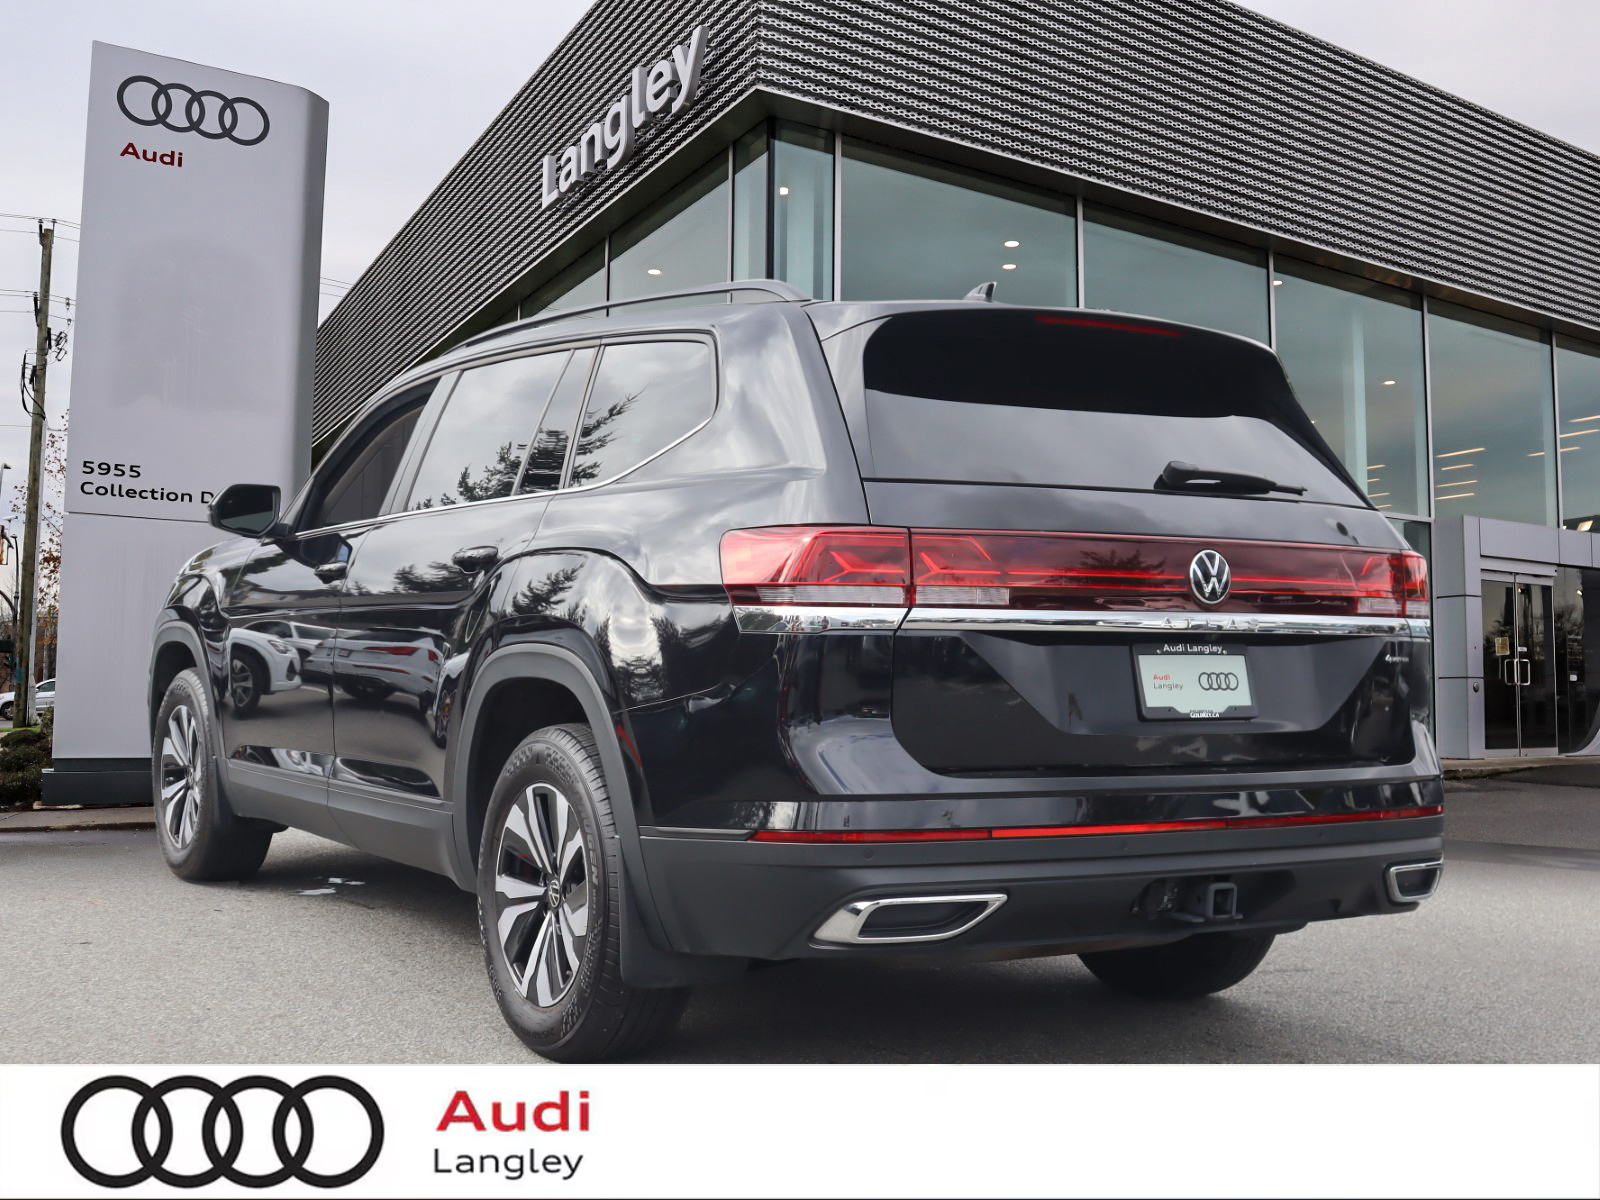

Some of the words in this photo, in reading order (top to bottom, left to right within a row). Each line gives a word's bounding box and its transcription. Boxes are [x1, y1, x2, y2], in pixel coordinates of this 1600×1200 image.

[542, 25, 709, 209] Langley
[120, 142, 183, 167] Audi
[82, 460, 141, 478] 5955
[80, 481, 192, 502] Collection
[1163, 644, 1185, 652] Audi
[1187, 644, 1223, 654] Langley
[1152, 673, 1171, 681] Audi
[1153, 682, 1184, 691] Langley
